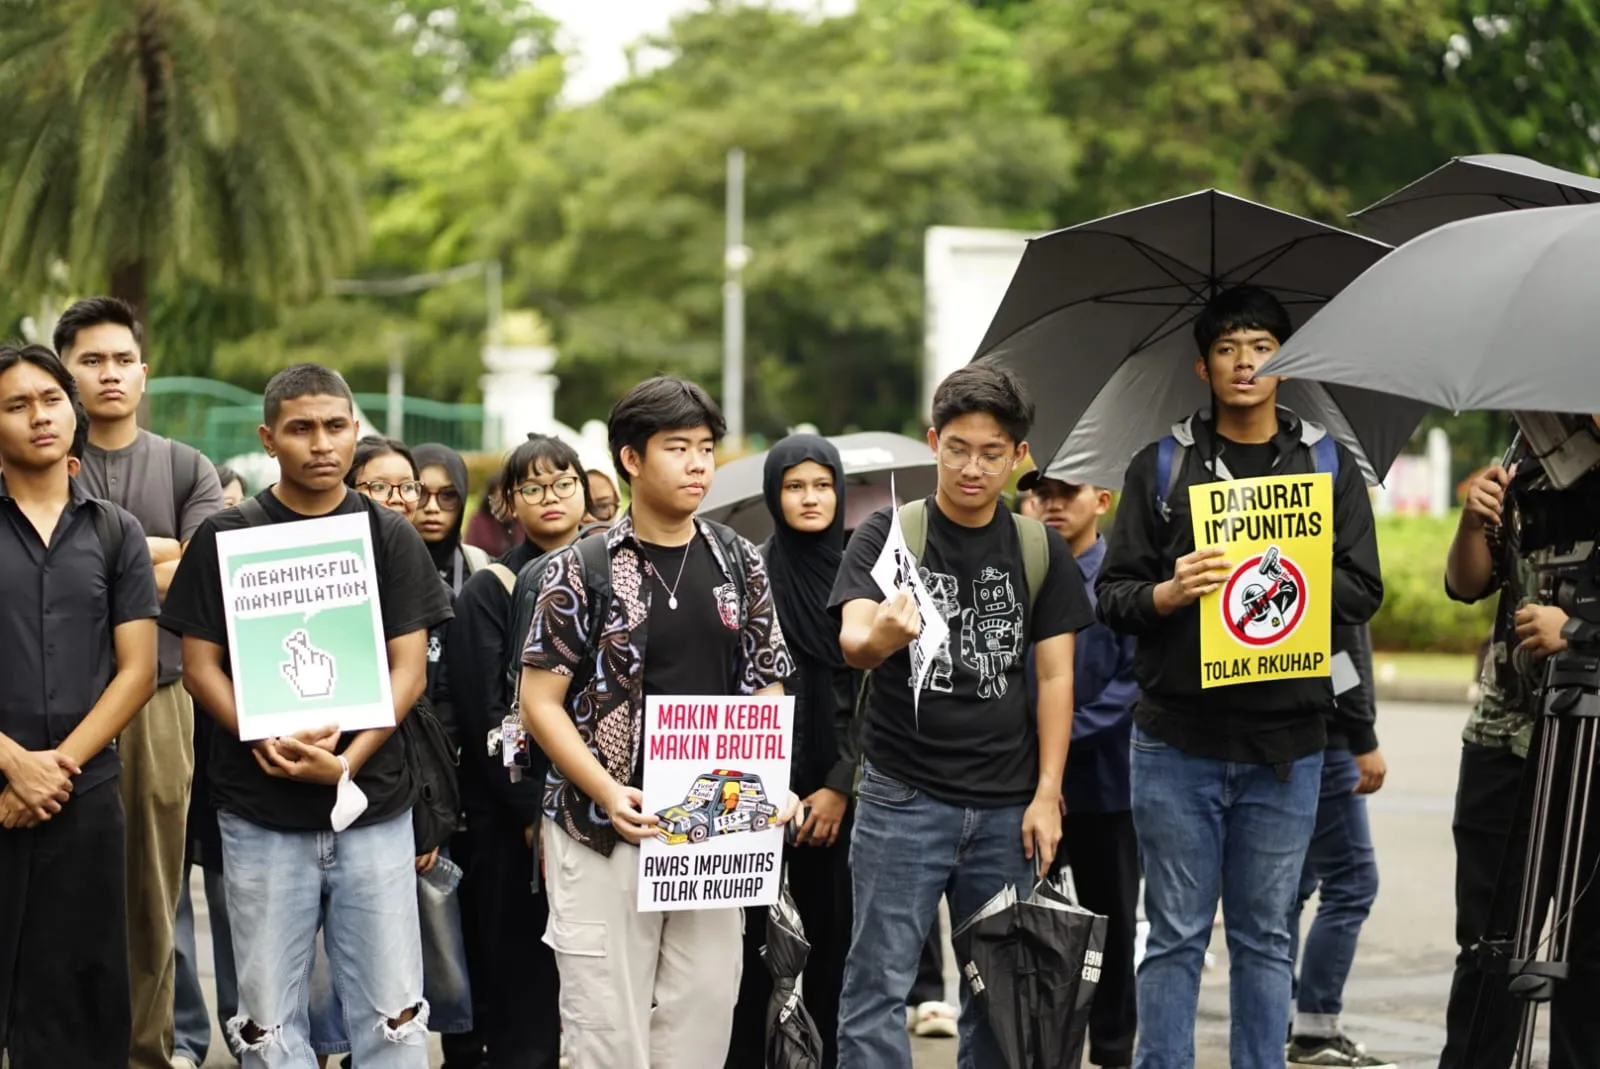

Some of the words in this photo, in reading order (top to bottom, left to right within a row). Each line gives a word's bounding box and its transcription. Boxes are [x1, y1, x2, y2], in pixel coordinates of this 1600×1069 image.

[1210, 482, 1314, 514] DARURAT
[1205, 512, 1322, 544] IMPUNITAS
[240, 559, 359, 588] MEANINGFUL
[234, 580, 368, 612] MANIPULATION
[1204, 658, 1252, 681] TOLAK
[1257, 652, 1324, 674] RKUHAP
[657, 704, 718, 729] MAKIN
[724, 704, 781, 729] KEBAL
[650, 734, 711, 760] MAKIN
[716, 733, 785, 759] BRUTAL
[717, 813, 745, 827] 135+
[644, 856, 689, 877] AWAS
[694, 852, 775, 875] IMPUNITAS
[652, 881, 698, 902] TOLAK
[703, 877, 763, 899] RKUHAP
